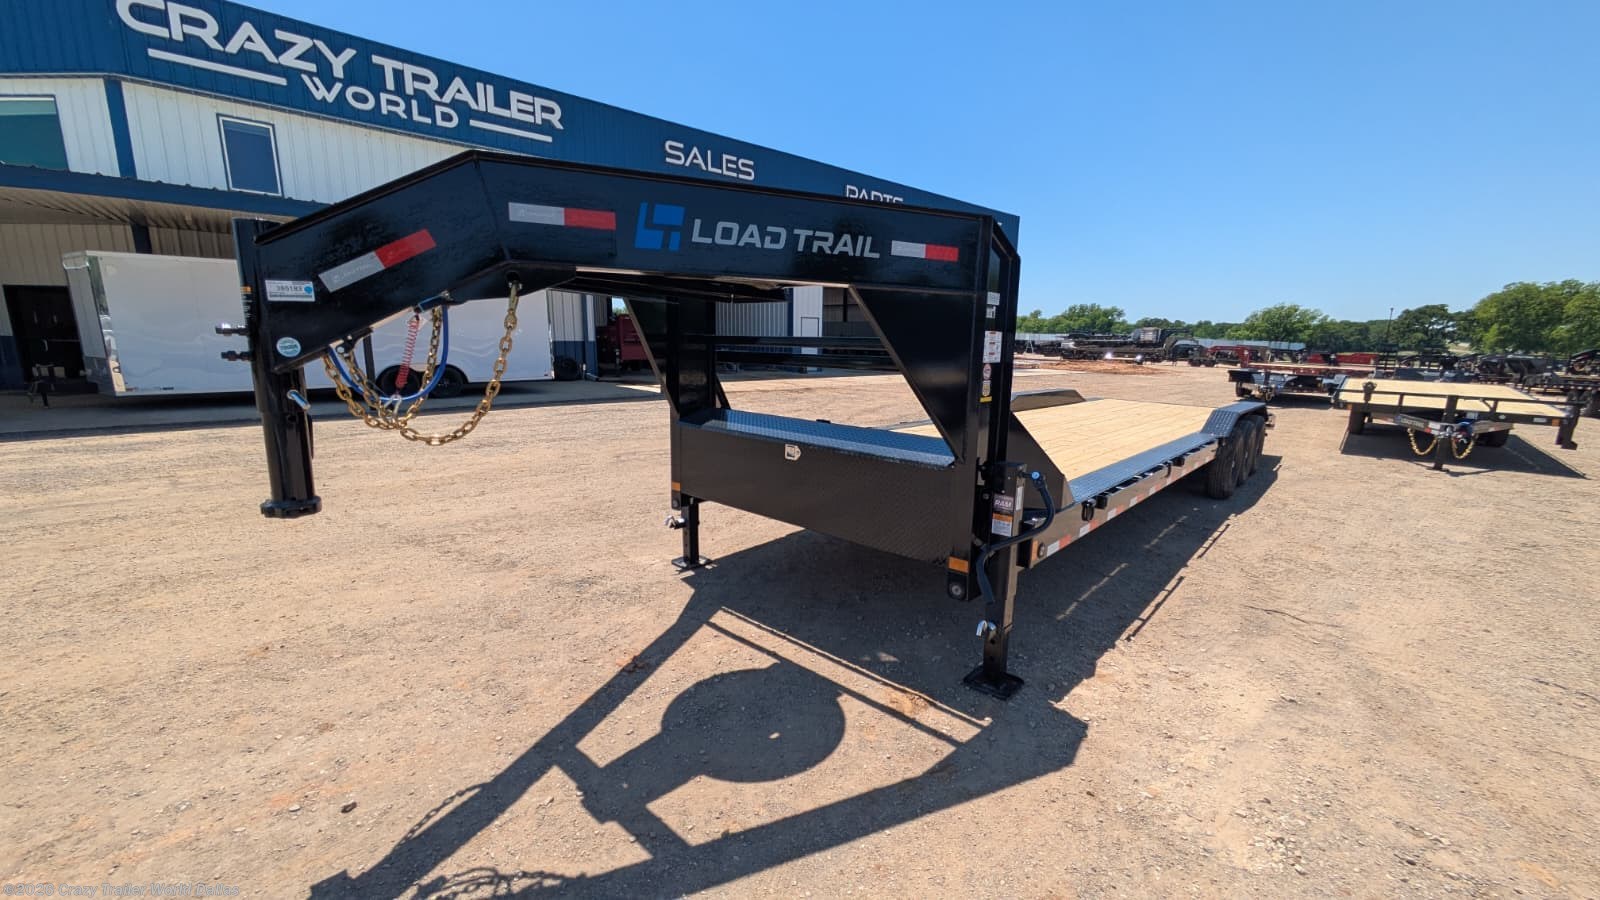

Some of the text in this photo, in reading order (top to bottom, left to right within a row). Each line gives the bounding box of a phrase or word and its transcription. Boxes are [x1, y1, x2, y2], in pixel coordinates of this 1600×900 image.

[116, 0, 564, 130] CRAZY TRAILER
[301, 74, 459, 129] WORLD
[664, 140, 755, 180] SALES
[691, 218, 880, 258] LOAD TRAIL
